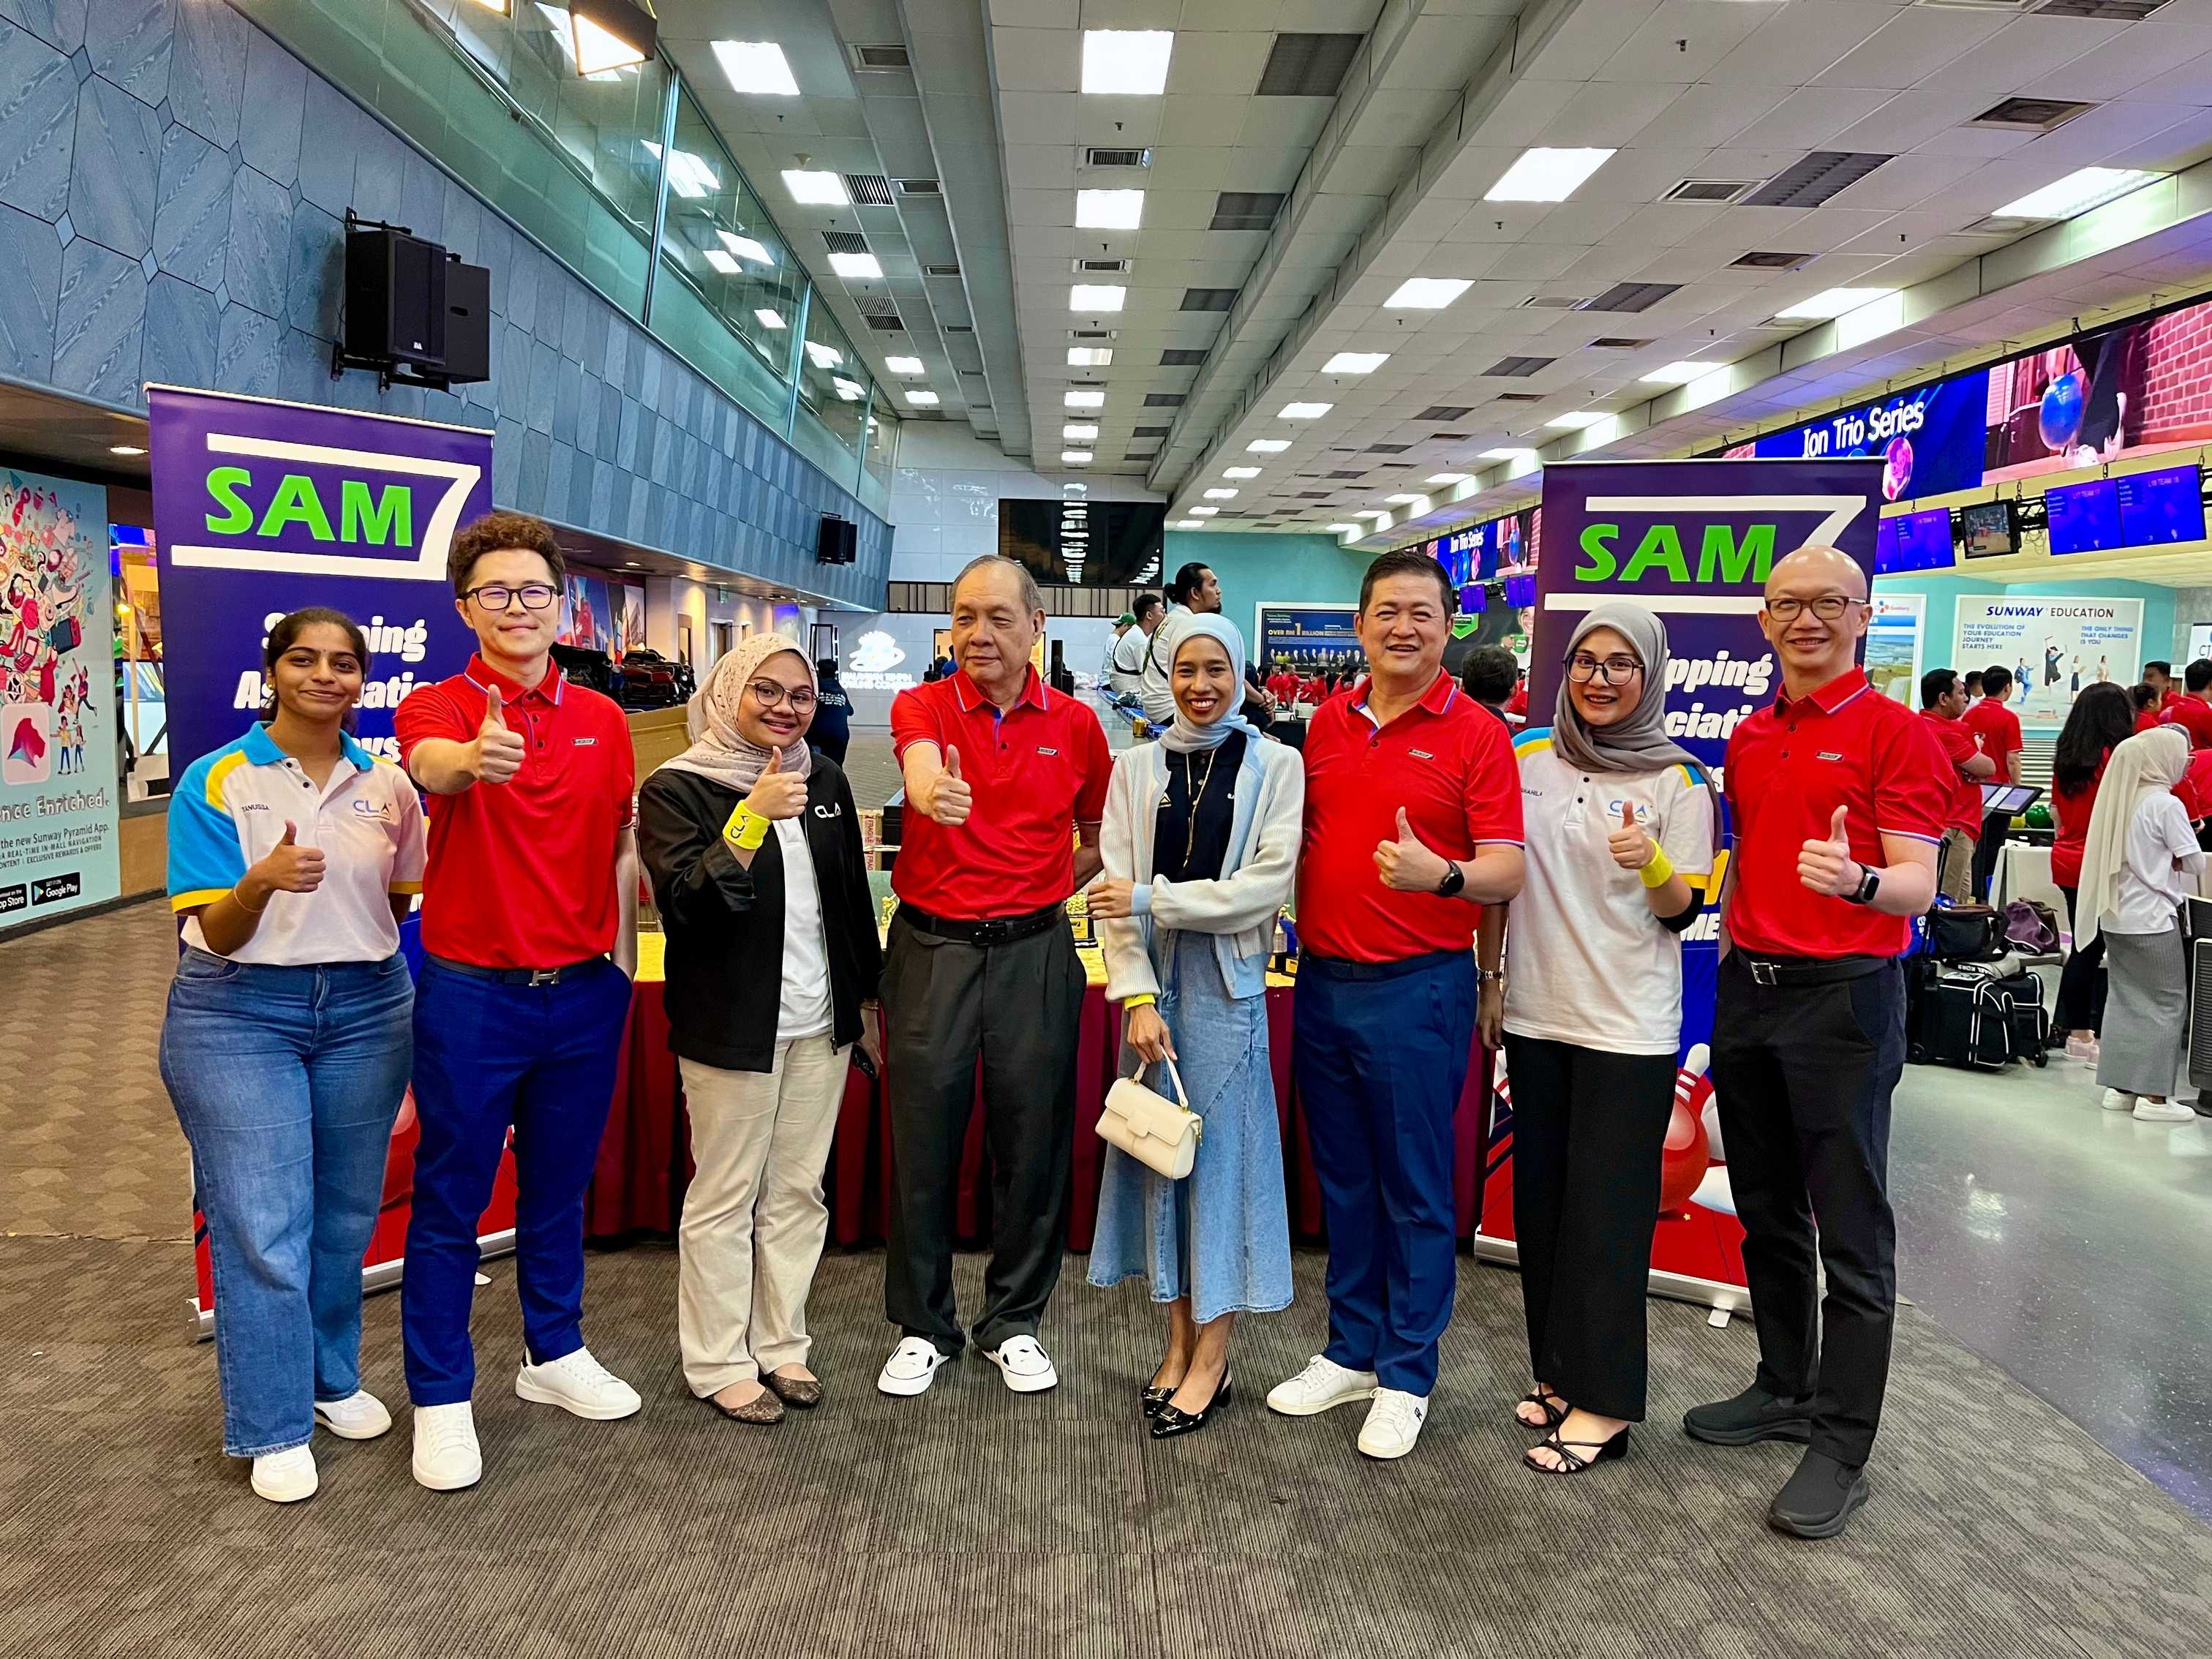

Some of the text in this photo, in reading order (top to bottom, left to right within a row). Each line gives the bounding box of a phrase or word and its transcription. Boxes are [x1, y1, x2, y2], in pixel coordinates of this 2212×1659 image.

[1802, 400, 1925, 458] Ion Trio Series
[1986, 606, 2115, 618] SUNWAY EDUCATION
[0, 803, 31, 822] nce
[815, 802, 841, 819] CLA
[1609, 800, 1647, 819] CA
[730, 814, 750, 839] CLA
[1, 838, 13, 849] the
[15, 837, 31, 846] new
[33, 832, 61, 844] Sunway
[64, 824, 93, 840] Pyramid
[7, 846, 40, 859] REAL-TIME
[68, 835, 102, 847] NAVIGATION
[26, 853, 54, 864] EXCLUSIVE
[55, 849, 79, 858] REWARDS
[84, 843, 102, 852] OFFERS
[45, 884, 78, 898] Google Play
[7, 896, 24, 907] Store
